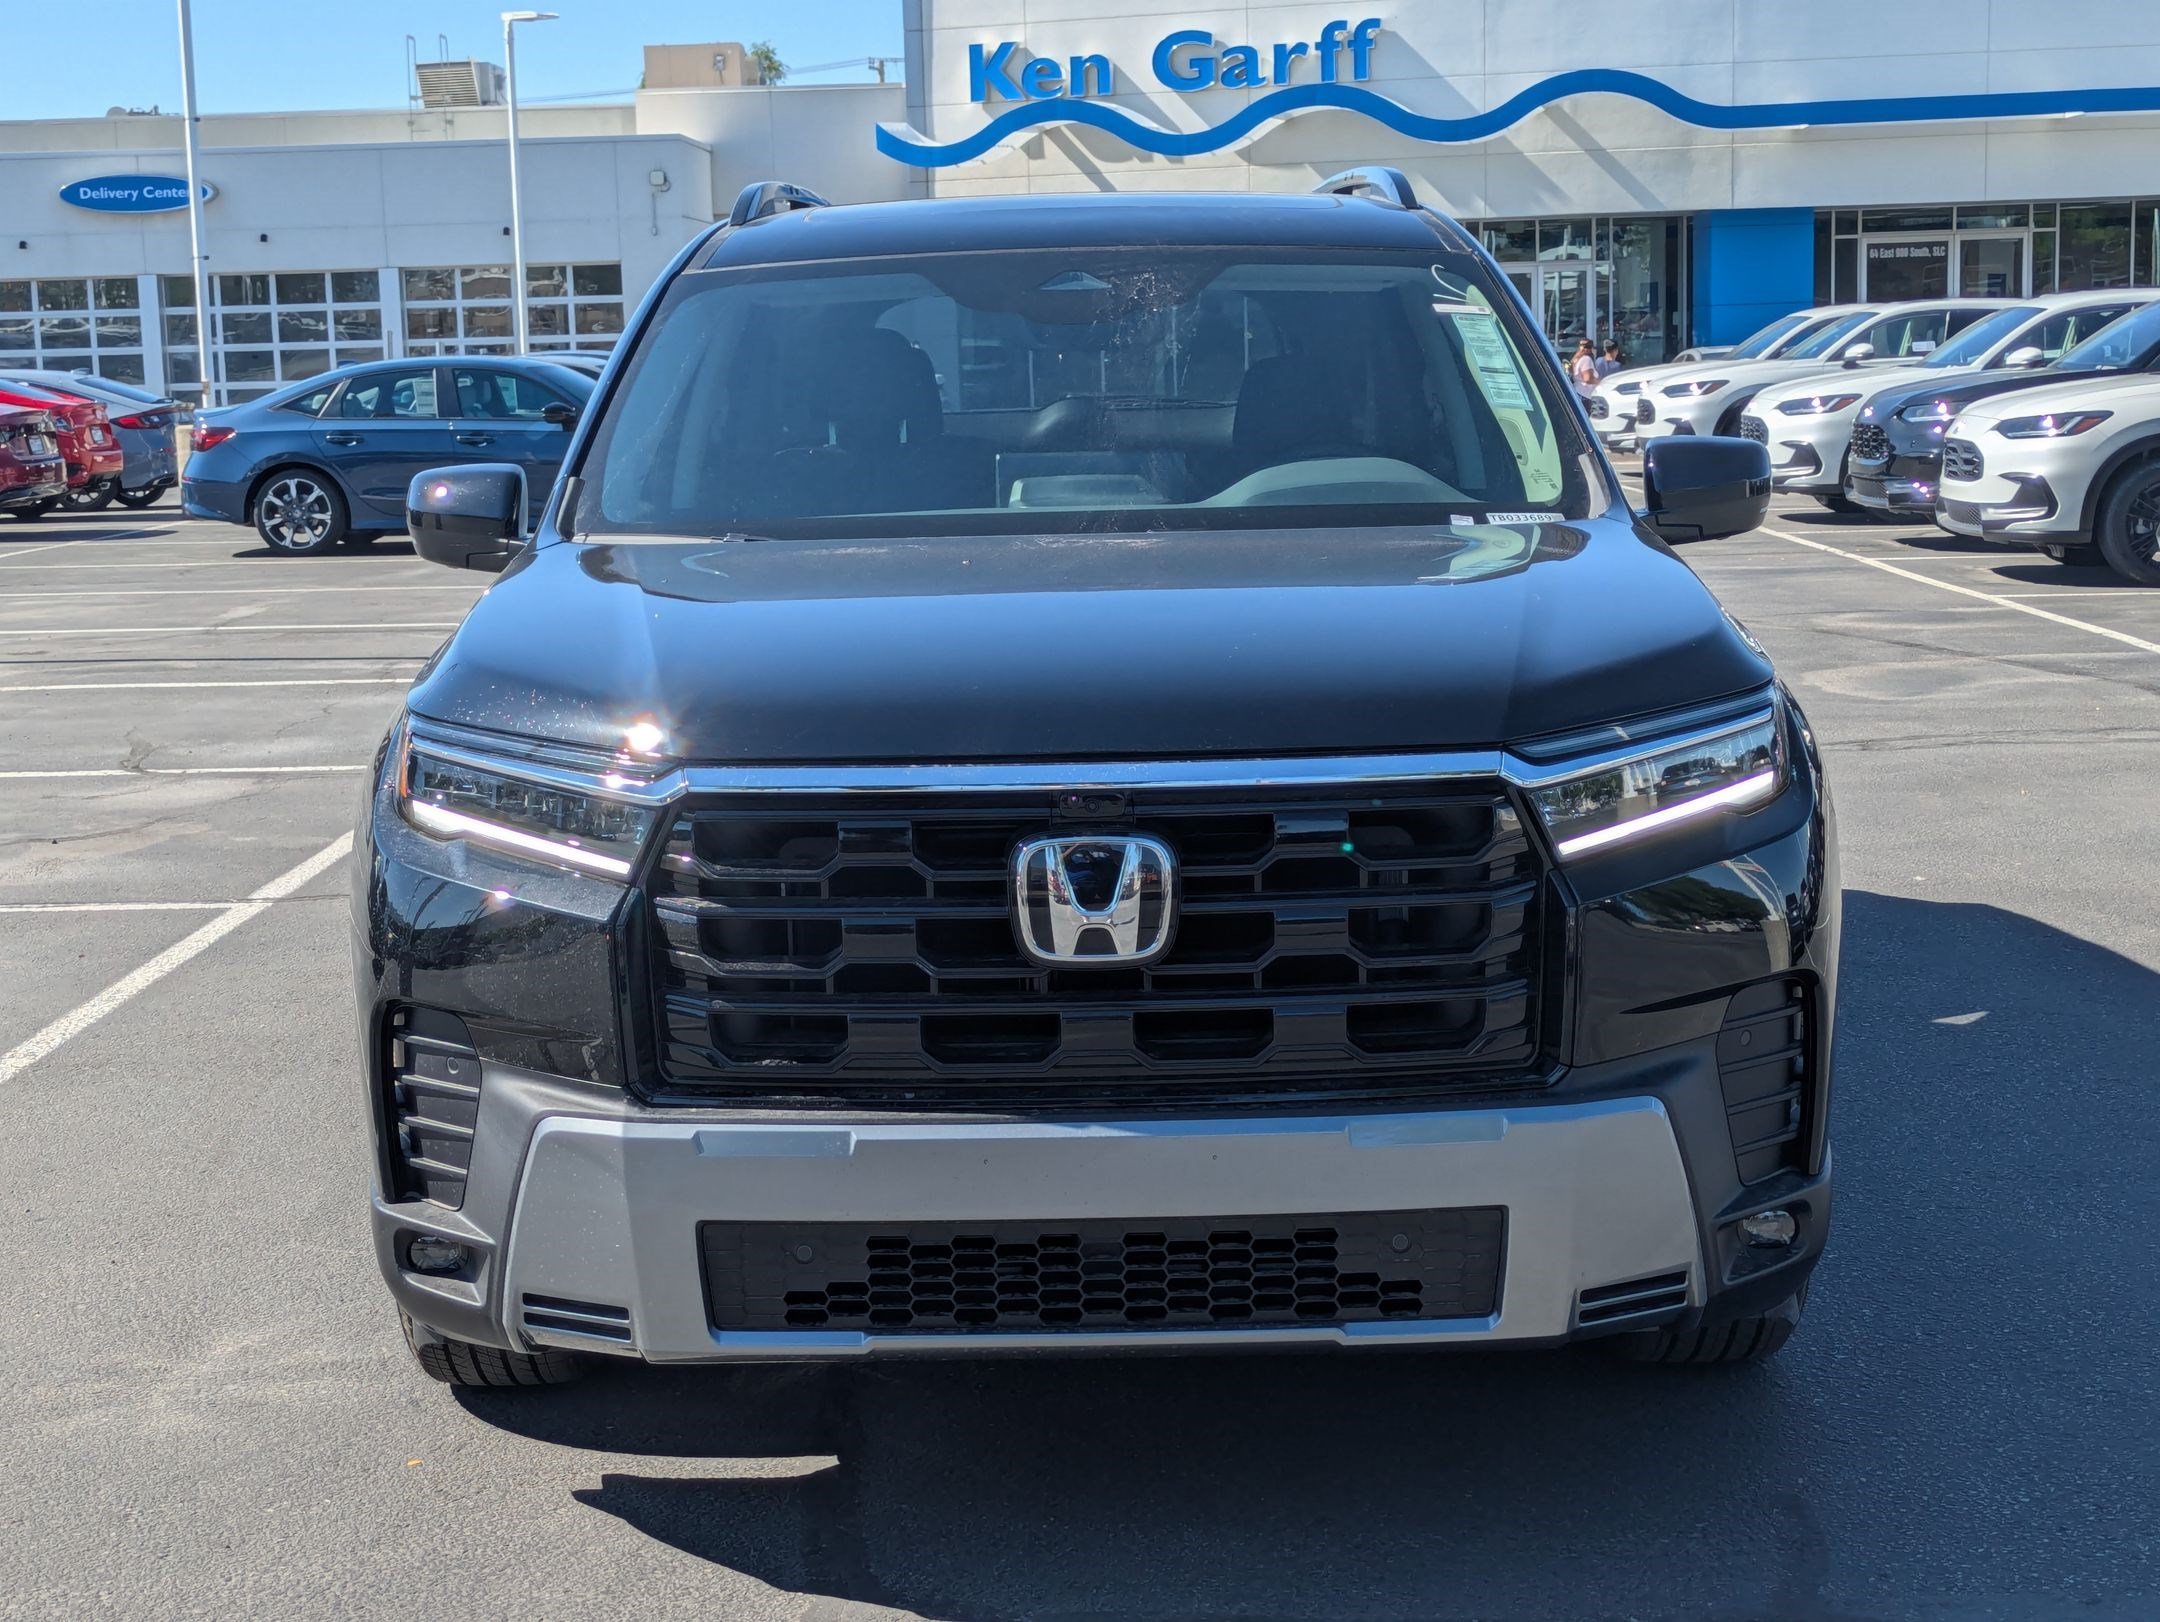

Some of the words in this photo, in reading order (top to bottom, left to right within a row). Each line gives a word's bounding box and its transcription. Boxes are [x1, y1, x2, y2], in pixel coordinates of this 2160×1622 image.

[968, 40, 1113, 103] Ken
[1152, 18, 1382, 93] Garff
[79, 187, 139, 202] Delivery
[143, 186, 190, 199] Cente
[1880, 247, 1895, 259] East
[1932, 245, 1946, 257] SLC
